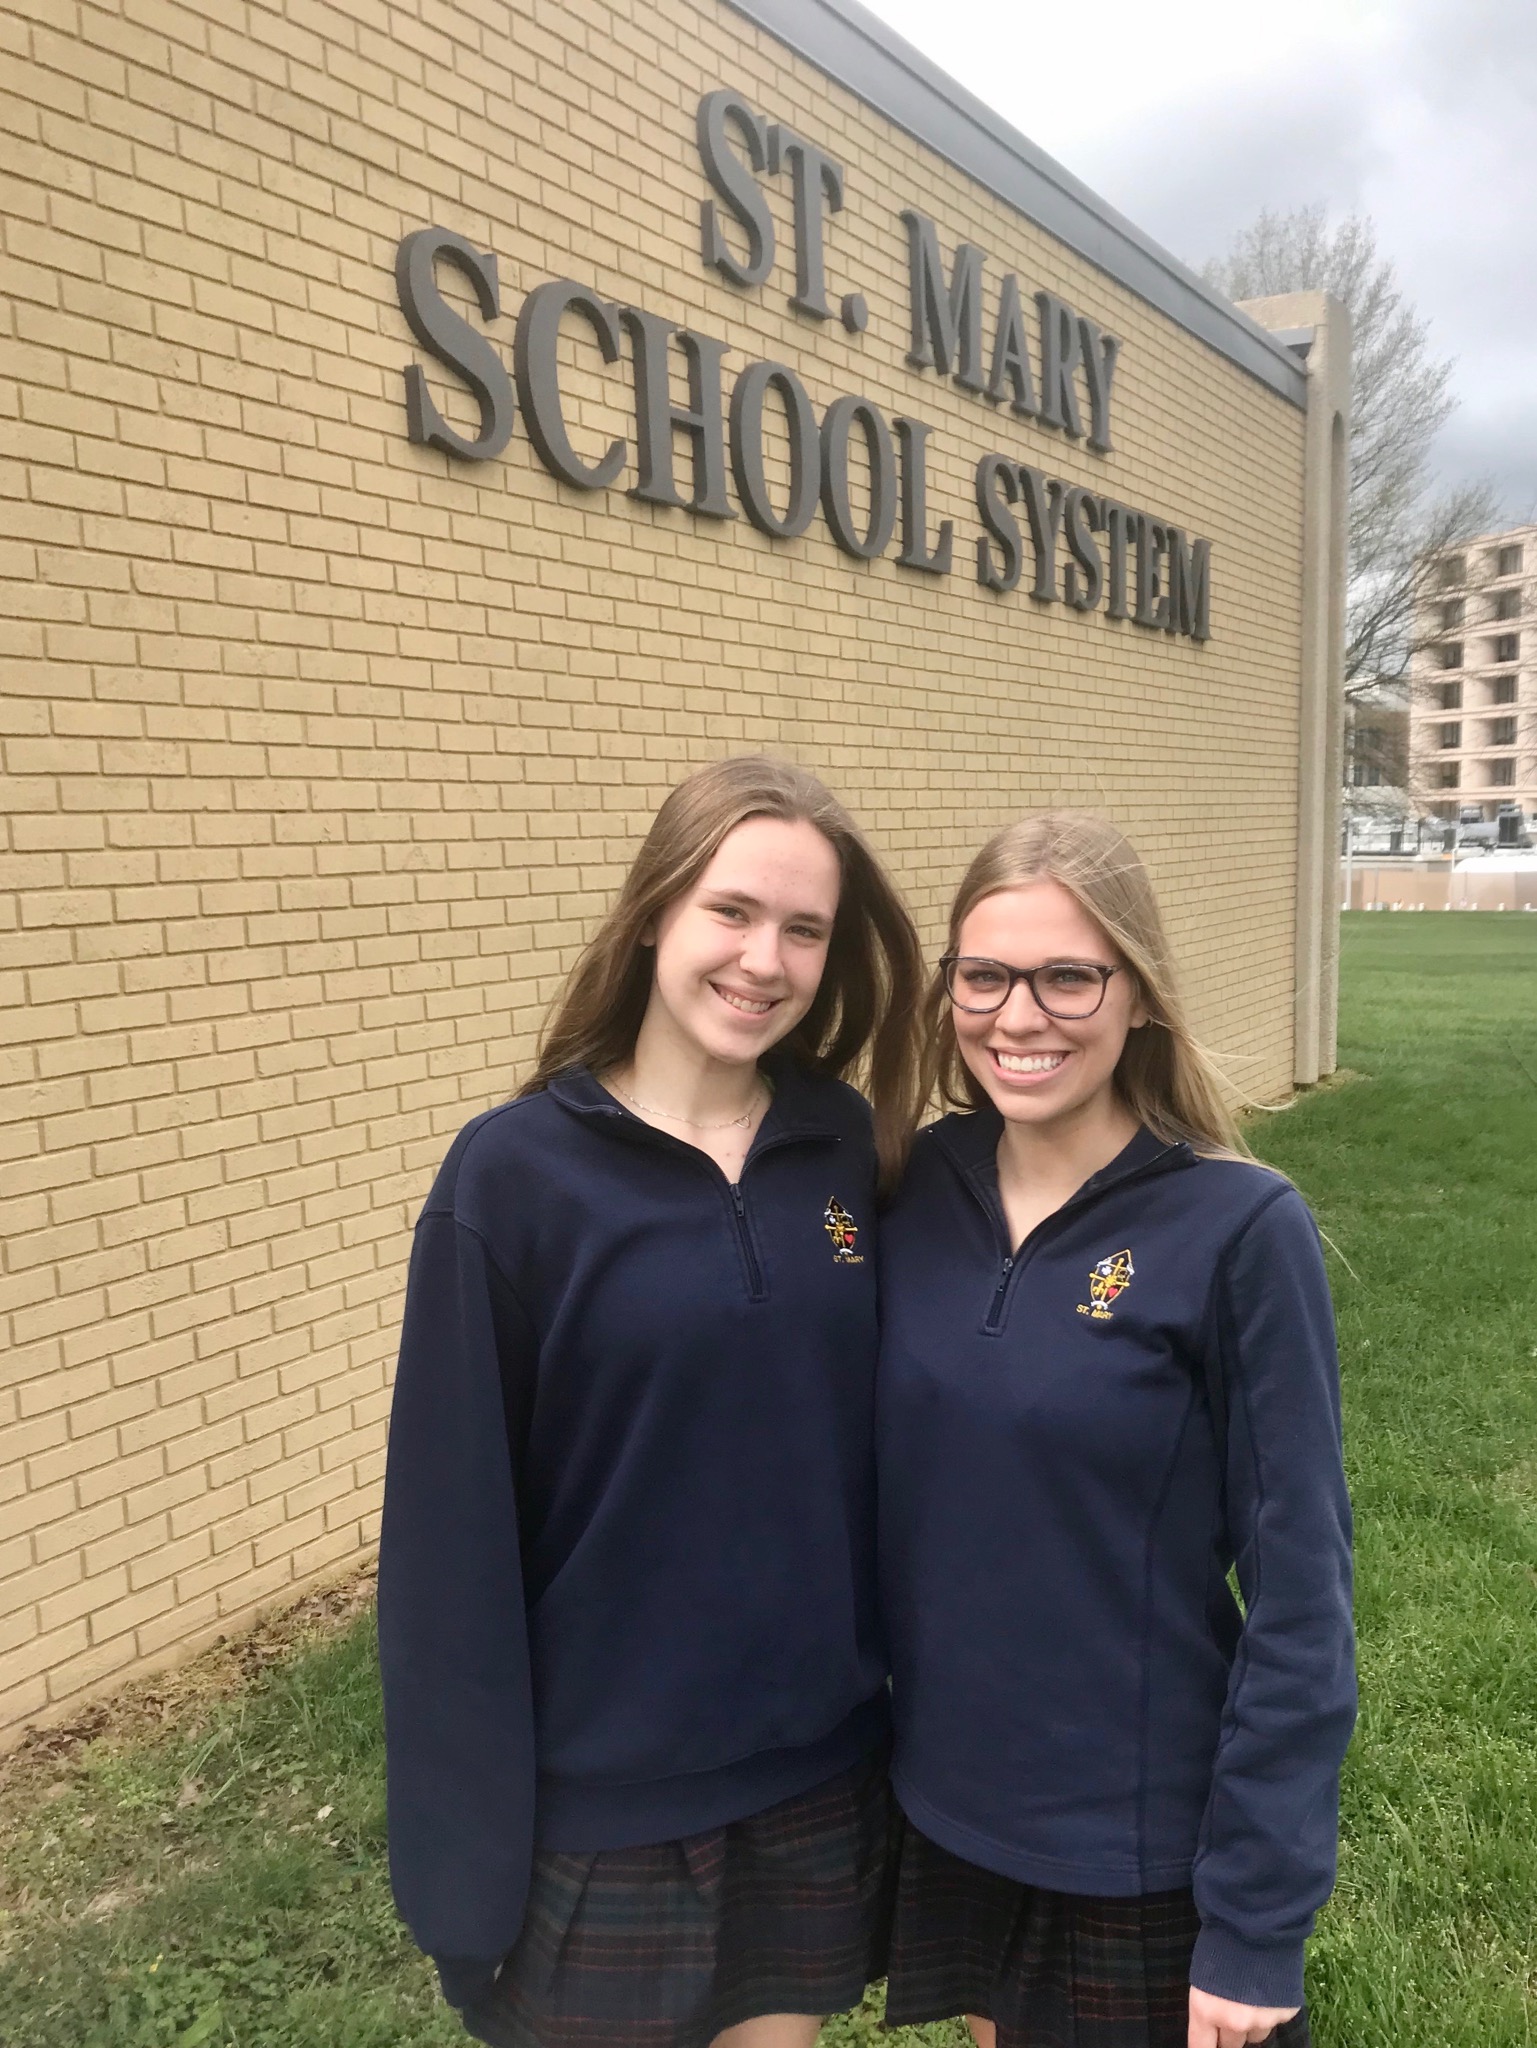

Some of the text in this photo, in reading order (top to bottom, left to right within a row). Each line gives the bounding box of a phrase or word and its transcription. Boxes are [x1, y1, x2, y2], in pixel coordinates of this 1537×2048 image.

[394, 226, 1213, 642] SCHOOL SYSTEM
[696, 89, 1122, 453] ST. MARY
[1076, 1304, 1089, 1315] ST.
